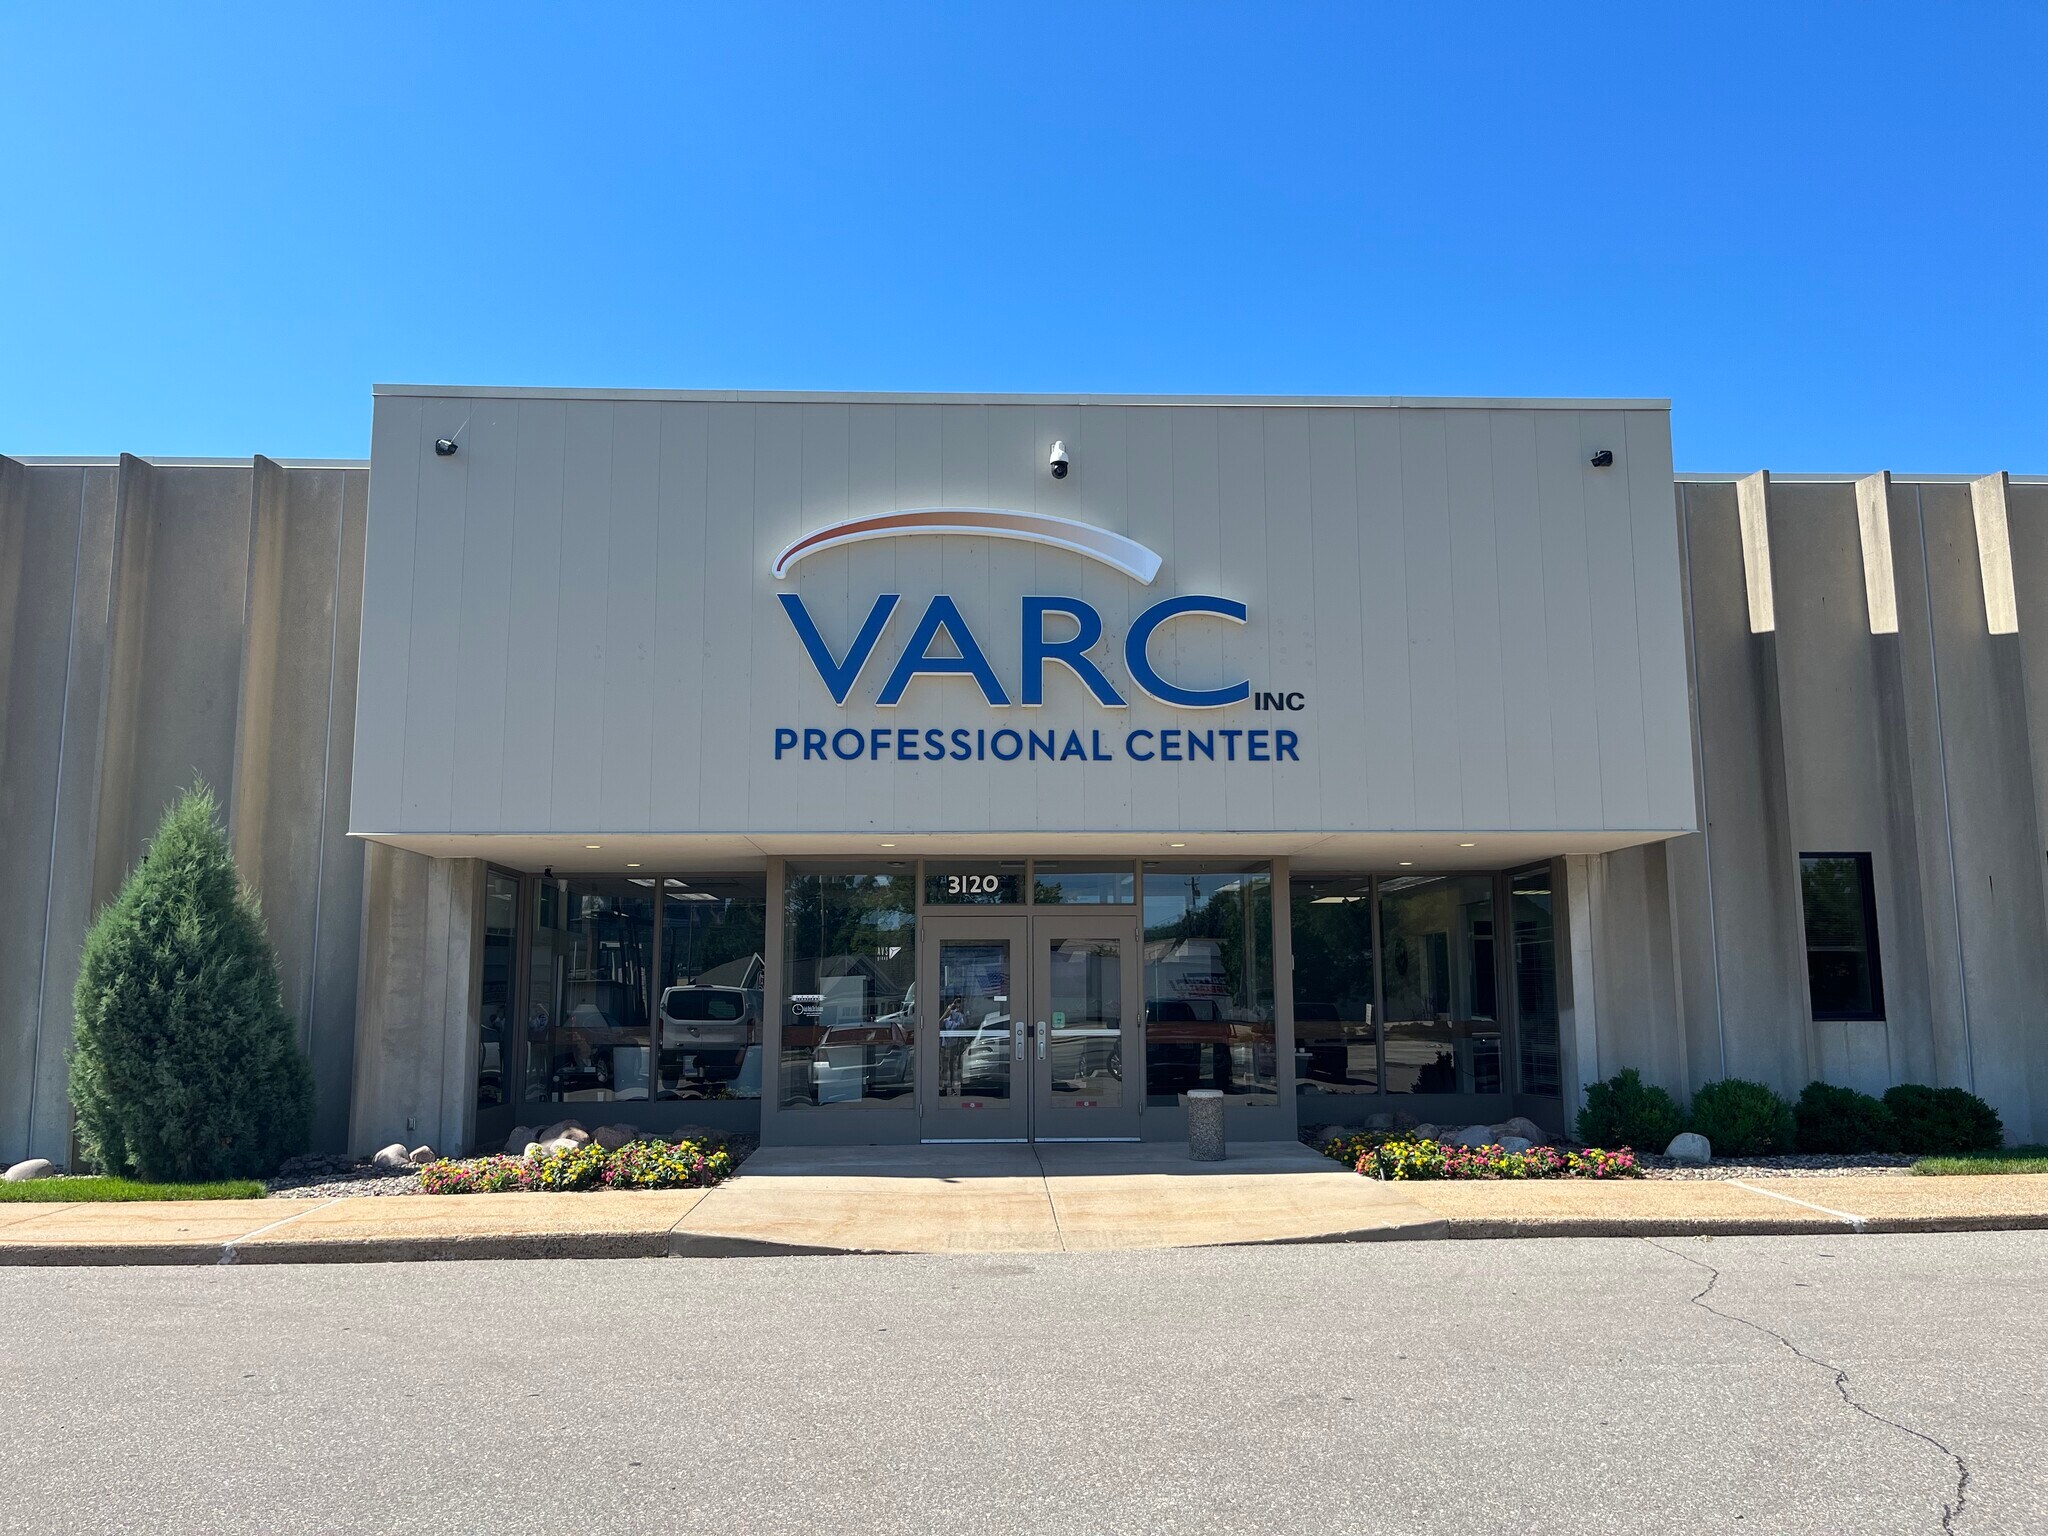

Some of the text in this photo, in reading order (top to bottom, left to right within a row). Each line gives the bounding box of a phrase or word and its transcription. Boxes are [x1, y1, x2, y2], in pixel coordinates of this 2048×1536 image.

[776, 593, 1305, 711] VARC INC
[774, 728, 1299, 761] PROFESSIONAL CENTER
[948, 874, 999, 894] 3120
